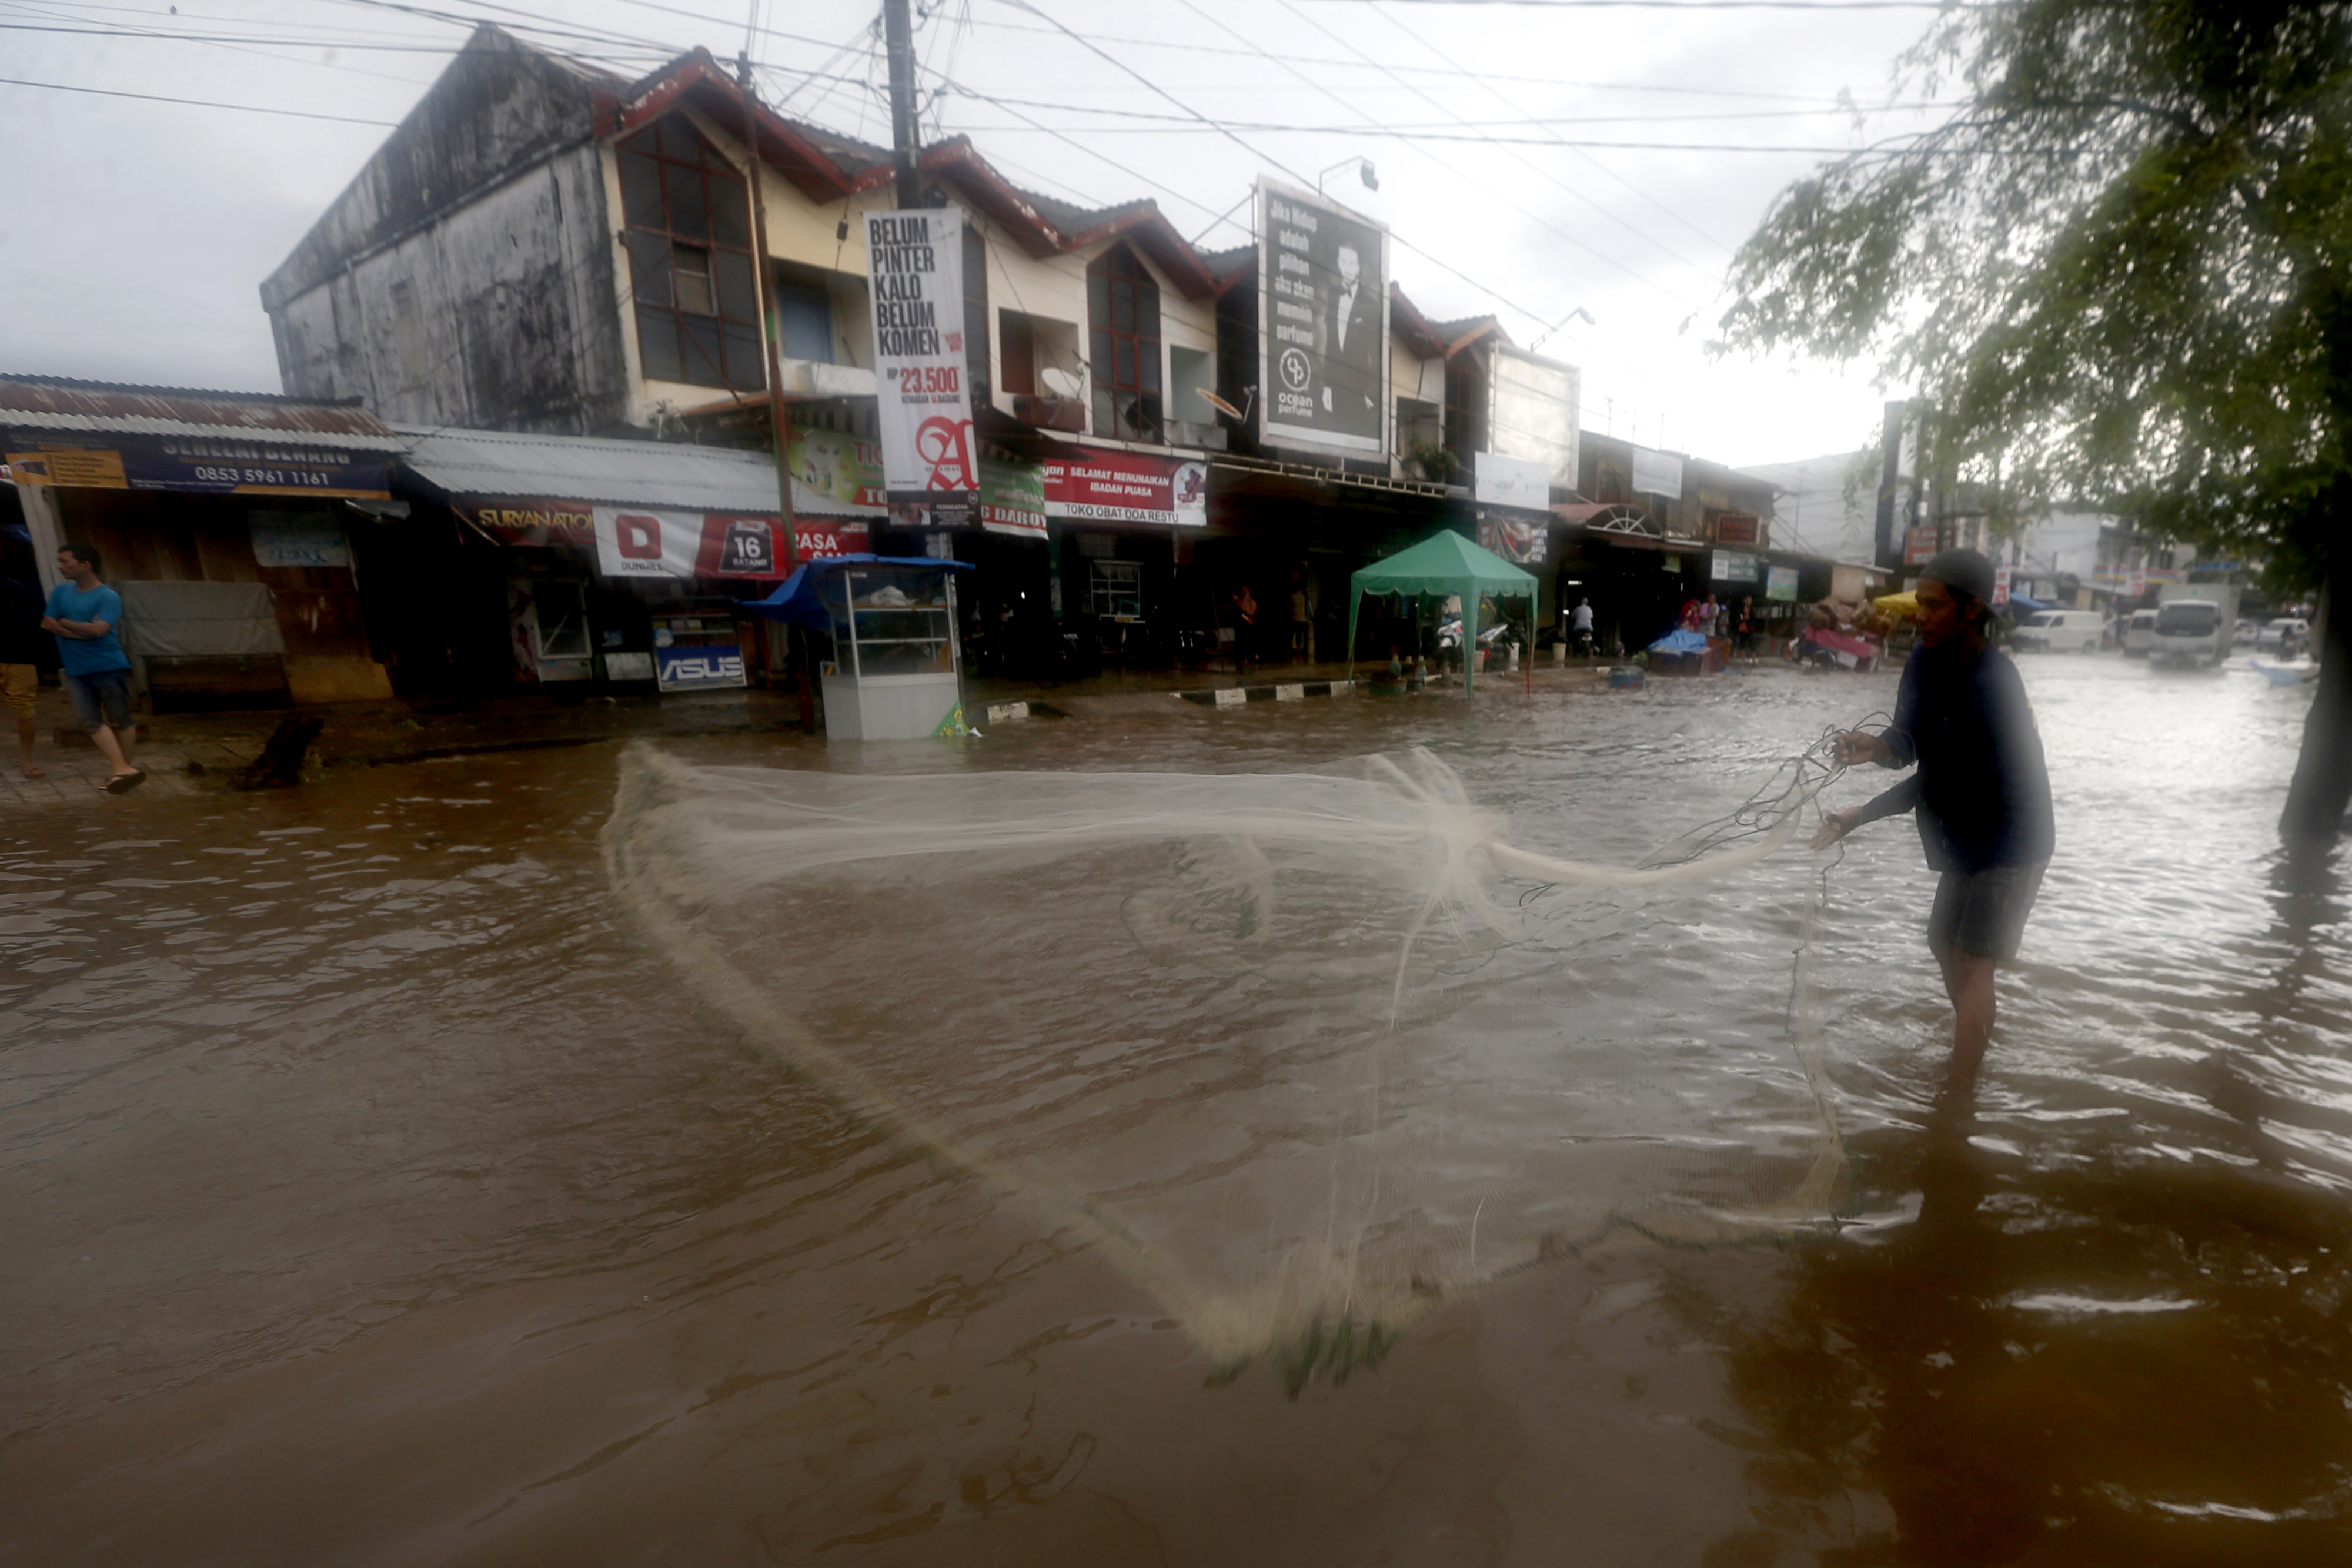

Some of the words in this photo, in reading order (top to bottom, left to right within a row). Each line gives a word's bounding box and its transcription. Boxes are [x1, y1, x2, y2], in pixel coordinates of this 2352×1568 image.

[870, 217, 928, 245] BELUM
[872, 245, 935, 272] PINTER
[874, 274, 921, 300] KALO
[877, 302, 934, 328] BELUM
[879, 329, 940, 355] KOMEN
[900, 367, 958, 393] 23.500
[1278, 392, 1312, 407] ocean
[195, 466, 240, 482] 0853
[245, 469, 285, 483] 5961
[291, 471, 329, 485] 1161
[1070, 466, 1112, 480] SELAMAT
[1113, 472, 1170, 486] MENUNAIKAN
[1090, 482, 1122, 494] IBADAH
[1125, 486, 1152, 497] PUASA
[1065, 504, 1093, 515] TOKO
[1097, 506, 1122, 517] OBAT
[1125, 509, 1146, 519] DOA
[1148, 511, 1178, 522] RESTU
[734, 537, 761, 558] 16
[662, 655, 743, 681] ASUS
